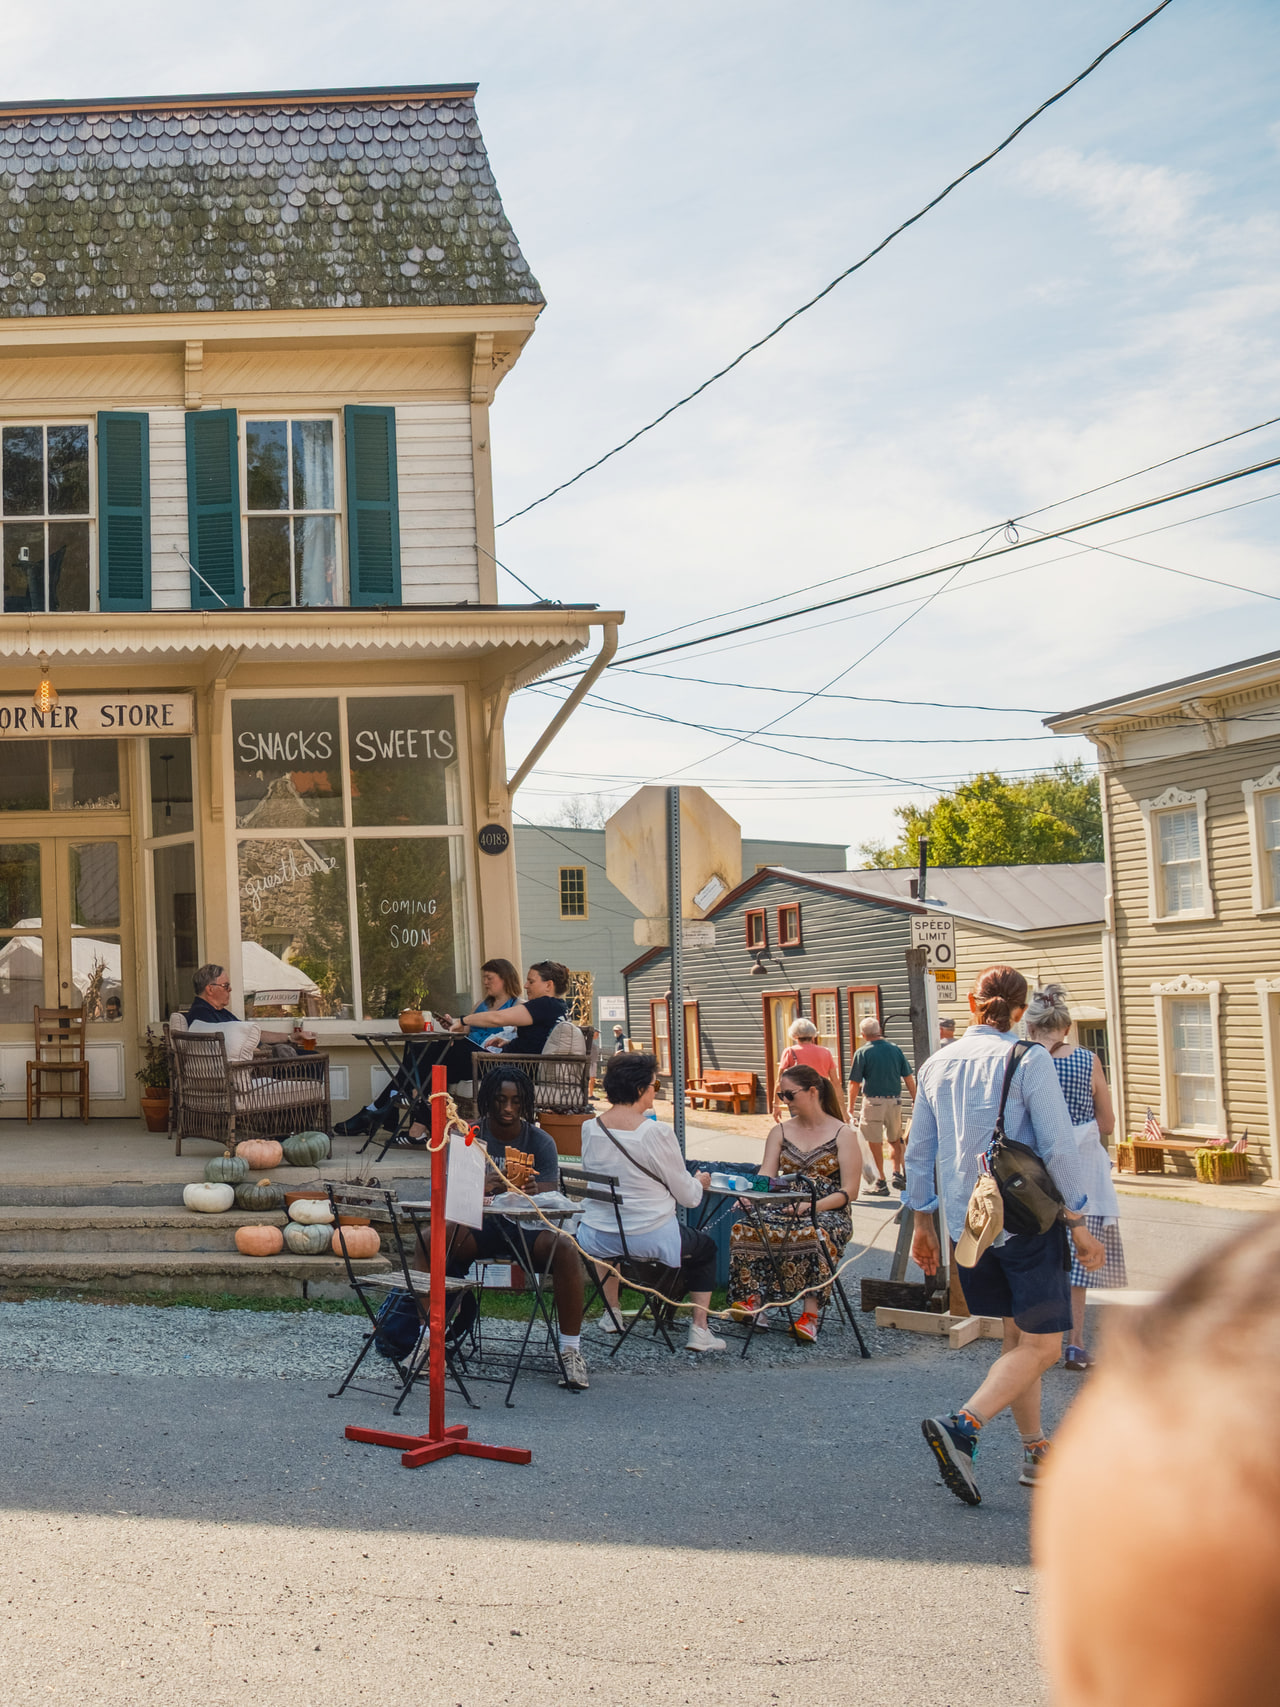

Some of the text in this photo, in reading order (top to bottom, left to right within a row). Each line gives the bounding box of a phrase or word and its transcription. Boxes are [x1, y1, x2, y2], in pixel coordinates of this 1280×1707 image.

[100, 703, 175, 729] STORE
[237, 730, 333, 763] SNACKS
[355, 729, 455, 762] SWEETS
[480, 833, 508, 846] 40183
[245, 849, 340, 912] guesthouse
[380, 899, 437, 915] COMING
[390, 924, 431, 949] SOON
[914, 921, 951, 930] SPEED
[918, 932, 948, 941] LIMIT
